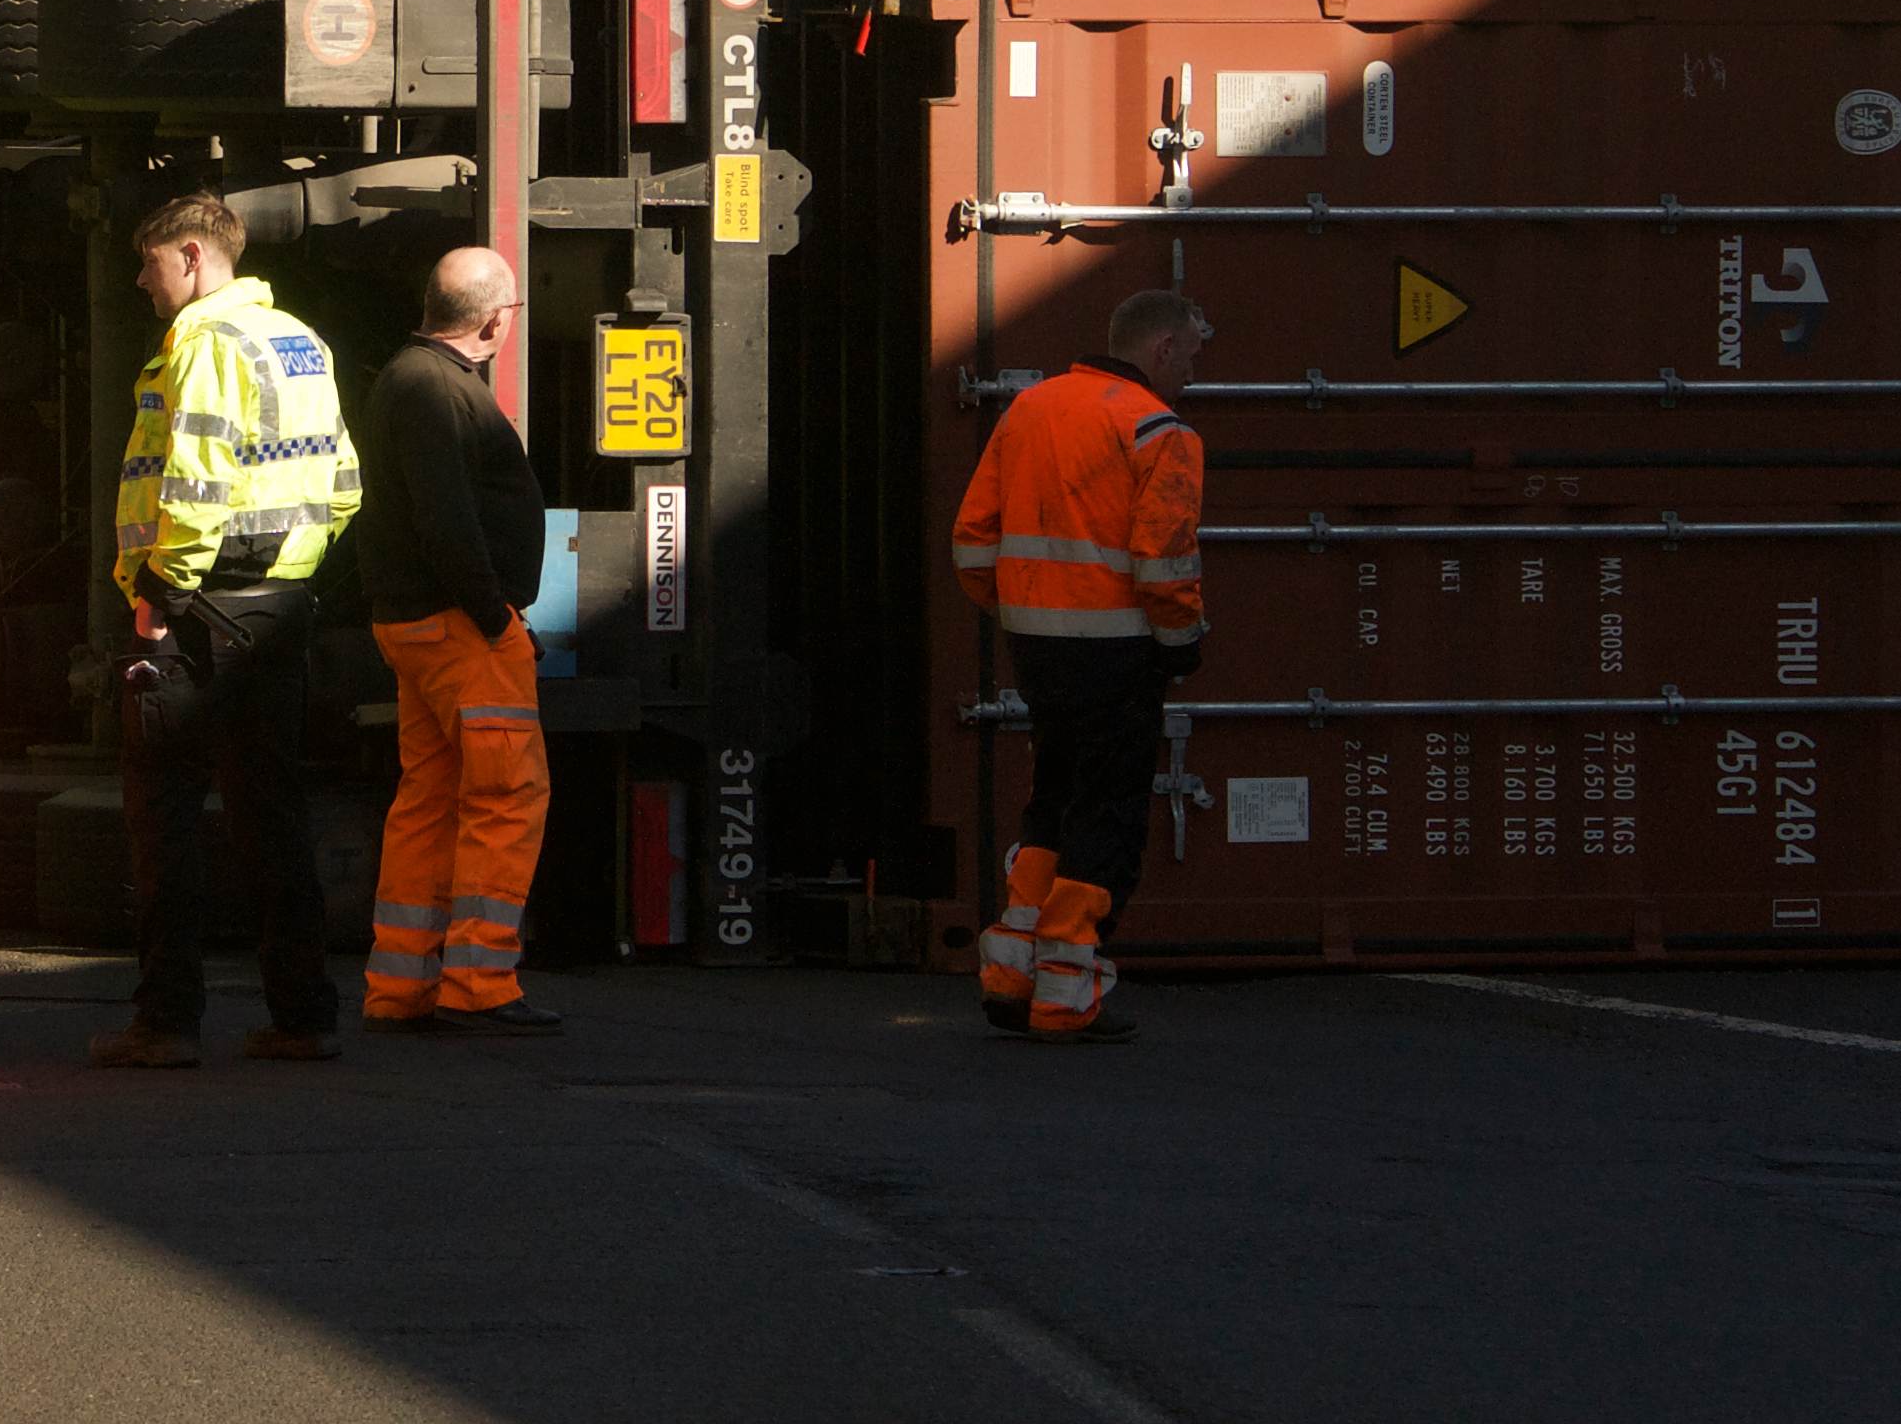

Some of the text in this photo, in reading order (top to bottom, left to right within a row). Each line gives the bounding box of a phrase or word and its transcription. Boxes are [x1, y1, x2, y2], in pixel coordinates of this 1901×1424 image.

[723, 34, 755, 151] CTL8
[1367, 81, 1376, 135] CONTAINER
[1379, 72, 1389, 144] CORTEN STEEL
[724, 171, 734, 225] Take care
[737, 164, 751, 233] Blind spot
[1412, 292, 1420, 322] HEAVY
[1718, 233, 1744, 370] TRITON
[278, 349, 326, 375] POLICE
[606, 353, 638, 426] LTU
[644, 339, 677, 439] EY20
[656, 492, 674, 626] DENNISON
[1441, 559, 1460, 593] NET
[1521, 557, 1544, 603] TARE
[1358, 562, 1379, 649] CU. CAP.
[1600, 557, 1623, 673] MAX. GROSS
[1776, 597, 1818, 686] TRHU
[1366, 753, 1388, 796] 76.4
[1716, 729, 1758, 816] 45G1
[1775, 730, 1817, 866] 612484
[718, 749, 755, 946] 31749-19
[1426, 818, 1448, 855] LBS
[1453, 817, 1470, 856] KGS
[1504, 817, 1527, 855] LBS
[1534, 817, 1556, 855] KGS
[1584, 816, 1605, 854] LBS
[1613, 816, 1636, 855] KGS
